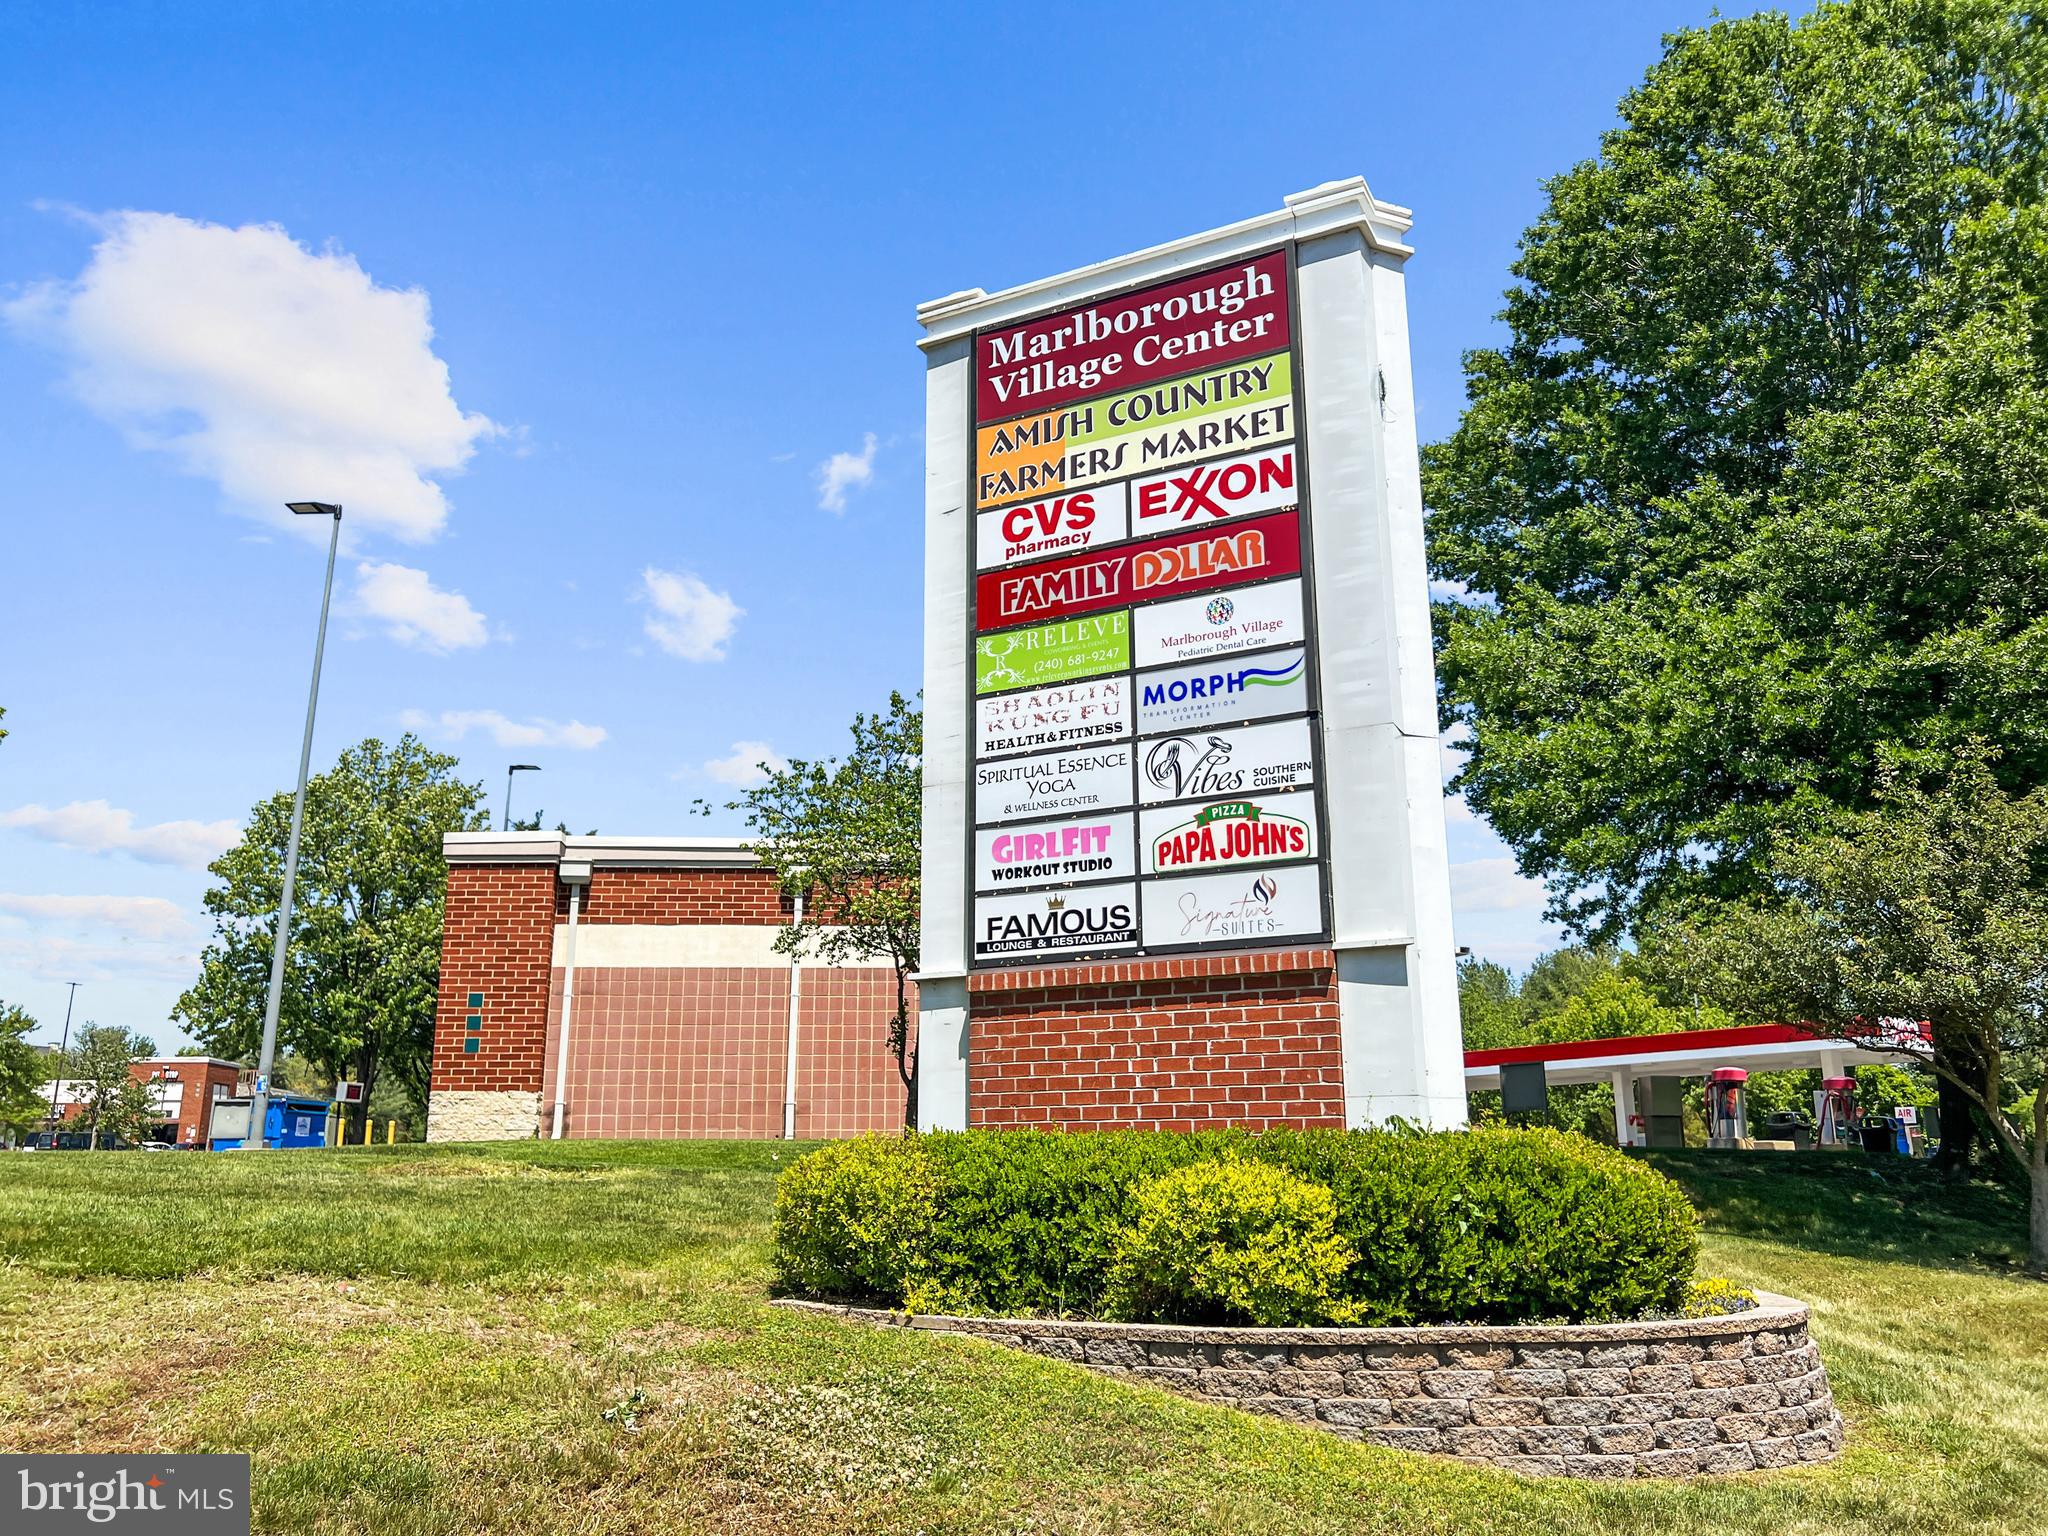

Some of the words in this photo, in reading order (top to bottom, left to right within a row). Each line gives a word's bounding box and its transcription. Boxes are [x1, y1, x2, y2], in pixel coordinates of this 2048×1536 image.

[988, 265, 1275, 369] Marlborough
[988, 353, 1123, 403] Village
[1132, 312, 1275, 367] Center
[989, 407, 1094, 457] AMISH
[1107, 361, 1274, 427] COUNTRY
[979, 441, 1129, 502] FARMERS
[1141, 403, 1291, 464] MARKET
[1138, 453, 1294, 522] EXXON
[1001, 493, 1097, 543] CVS
[1004, 530, 1092, 561] pharmacy
[1000, 556, 1127, 618] FAMILY
[1131, 529, 1266, 593] DOLLAR
[1160, 625, 1237, 648] Marlborough
[1241, 618, 1284, 634] Village
[1177, 645, 1214, 659] Pediatric
[1216, 639, 1244, 651] Dental
[1246, 636, 1267, 646] Care
[1033, 657, 1063, 674] (240)
[1067, 647, 1120, 667] 681-9247
[985, 681, 1122, 716] SHAOLIN
[1142, 671, 1245, 707] MORPH
[985, 709, 1072, 733] KUNG
[1080, 700, 1121, 720] FU
[1143, 700, 1236, 718] TRANSFORMATION
[1172, 711, 1211, 722] CENTER
[977, 762, 1055, 786] SPIRITUAL
[1057, 752, 1128, 775] ESSENCE
[1154, 735, 1246, 799] Vibes
[1253, 760, 1312, 777] SOUTHERN
[1253, 773, 1296, 787] CUISINE
[1003, 804, 1012, 814] &
[1014, 799, 1059, 813] WELLNESS
[1060, 794, 1100, 807] CENTER
[1026, 778, 1076, 800] YOGA
[1211, 804, 1245, 819] PIZZA
[991, 824, 1112, 864] GIRLFIT
[1158, 826, 1217, 867] PAPA
[1219, 822, 1305, 860] JOHN'S
[991, 863, 1061, 881] WORKOUT
[1063, 857, 1113, 874] STUDIO
[986, 904, 1132, 941] FAMOUS
[1178, 892, 1273, 936] Signature
[1220, 918, 1275, 936] SUITES
[986, 940, 1033, 953] LOUNGE
[1036, 938, 1047, 948] &
[1051, 931, 1130, 946] RESTAURANT
[1898, 1108, 1912, 1118] AIR
